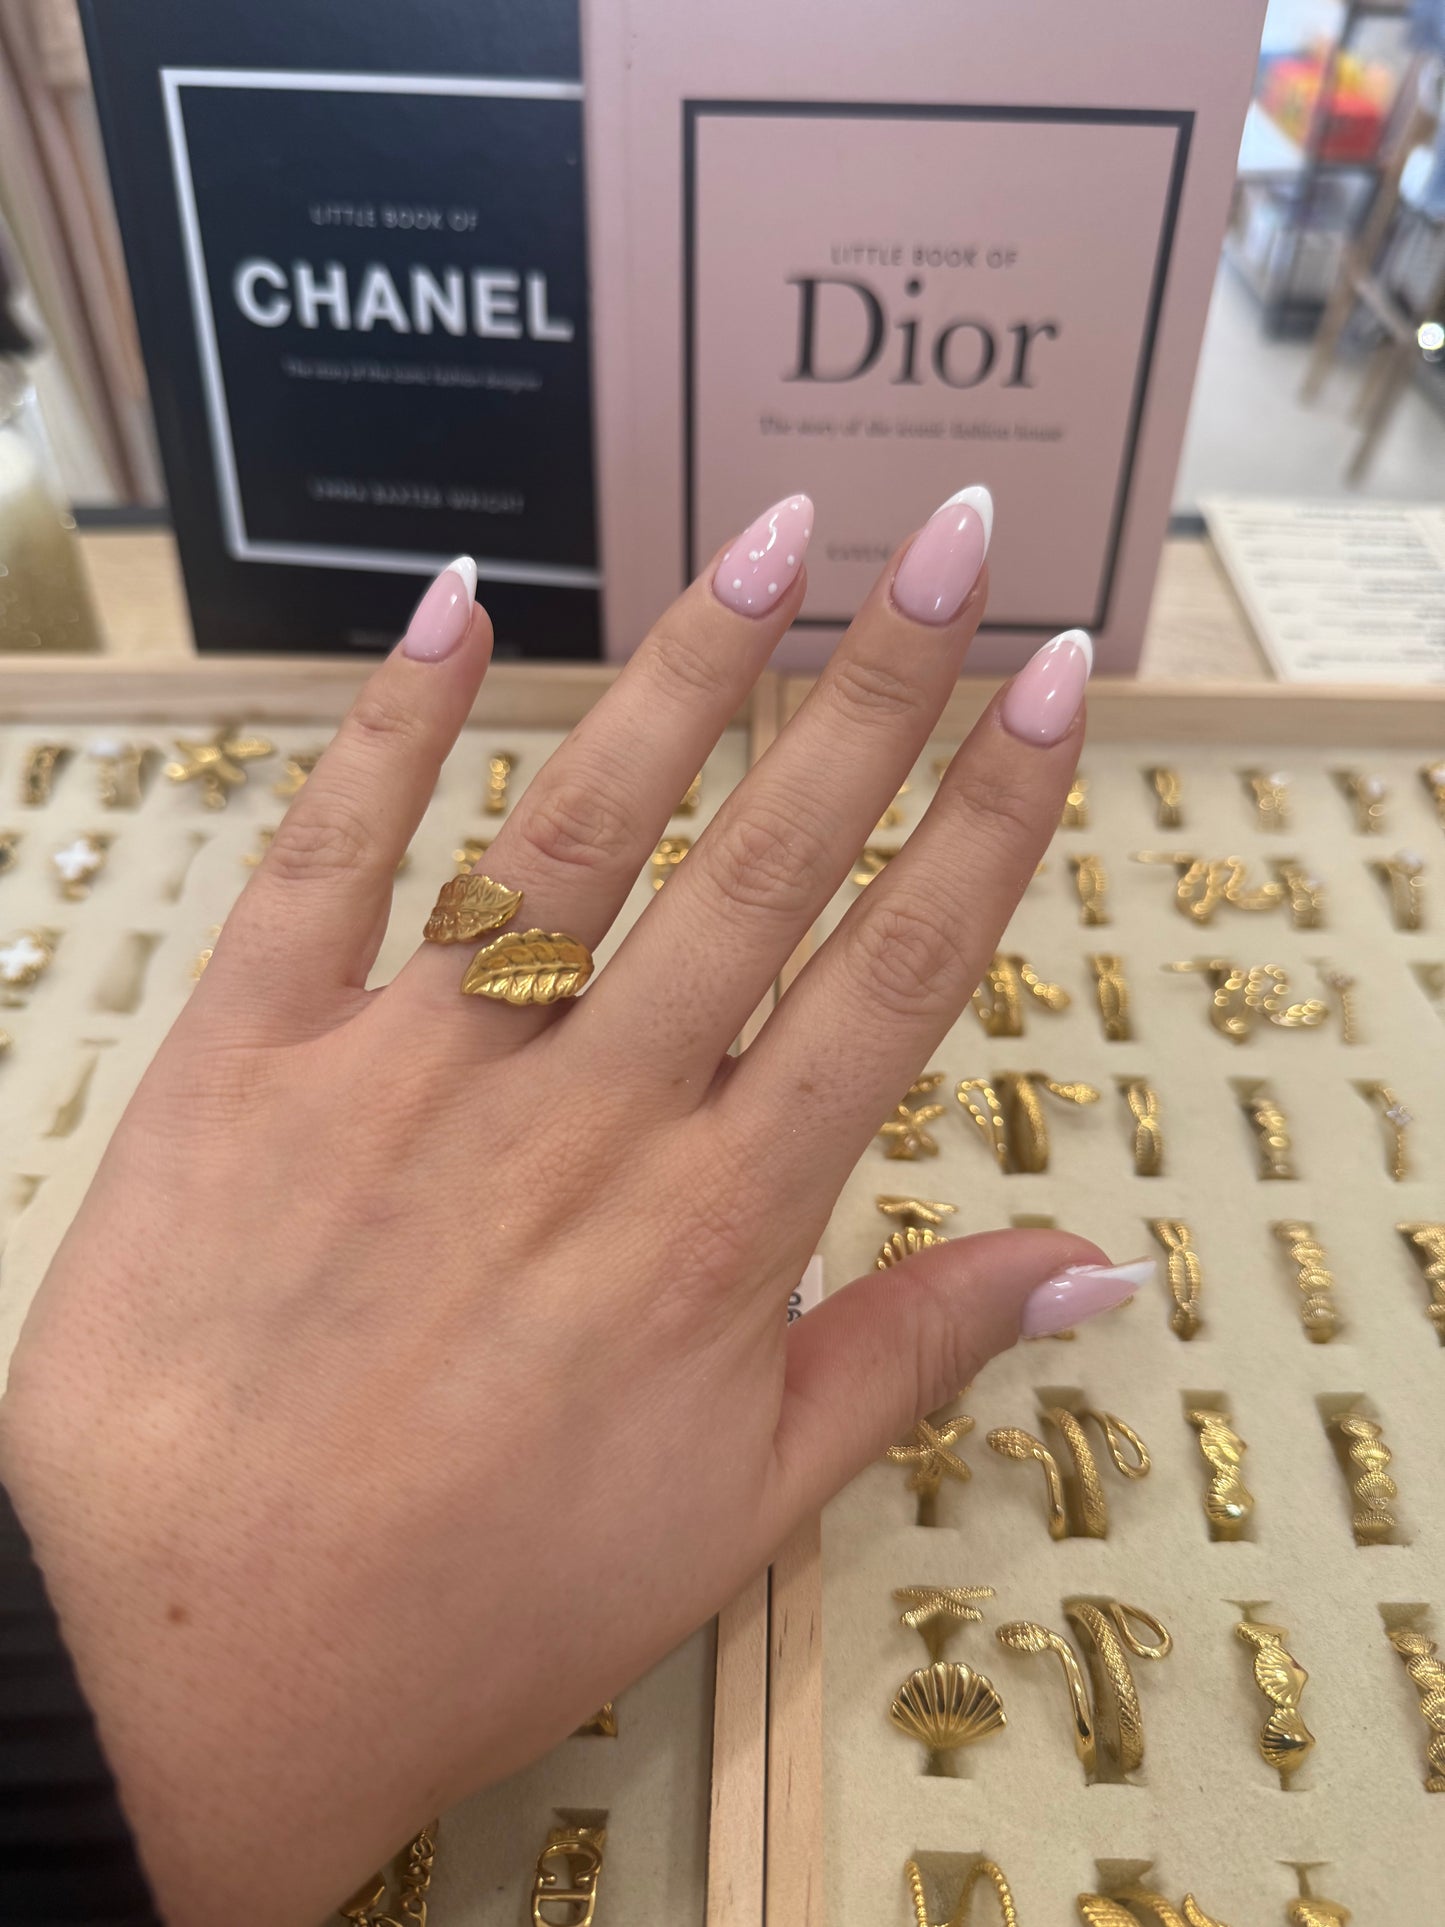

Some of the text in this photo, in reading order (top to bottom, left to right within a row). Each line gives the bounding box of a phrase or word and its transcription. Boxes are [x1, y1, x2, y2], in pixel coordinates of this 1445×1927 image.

[309, 205, 479, 231] LITTLE BOOK OF
[830, 243, 1018, 269] LITTLE BOOK OF
[233, 256, 574, 342] CHANEL
[781, 271, 1062, 389] Dior
